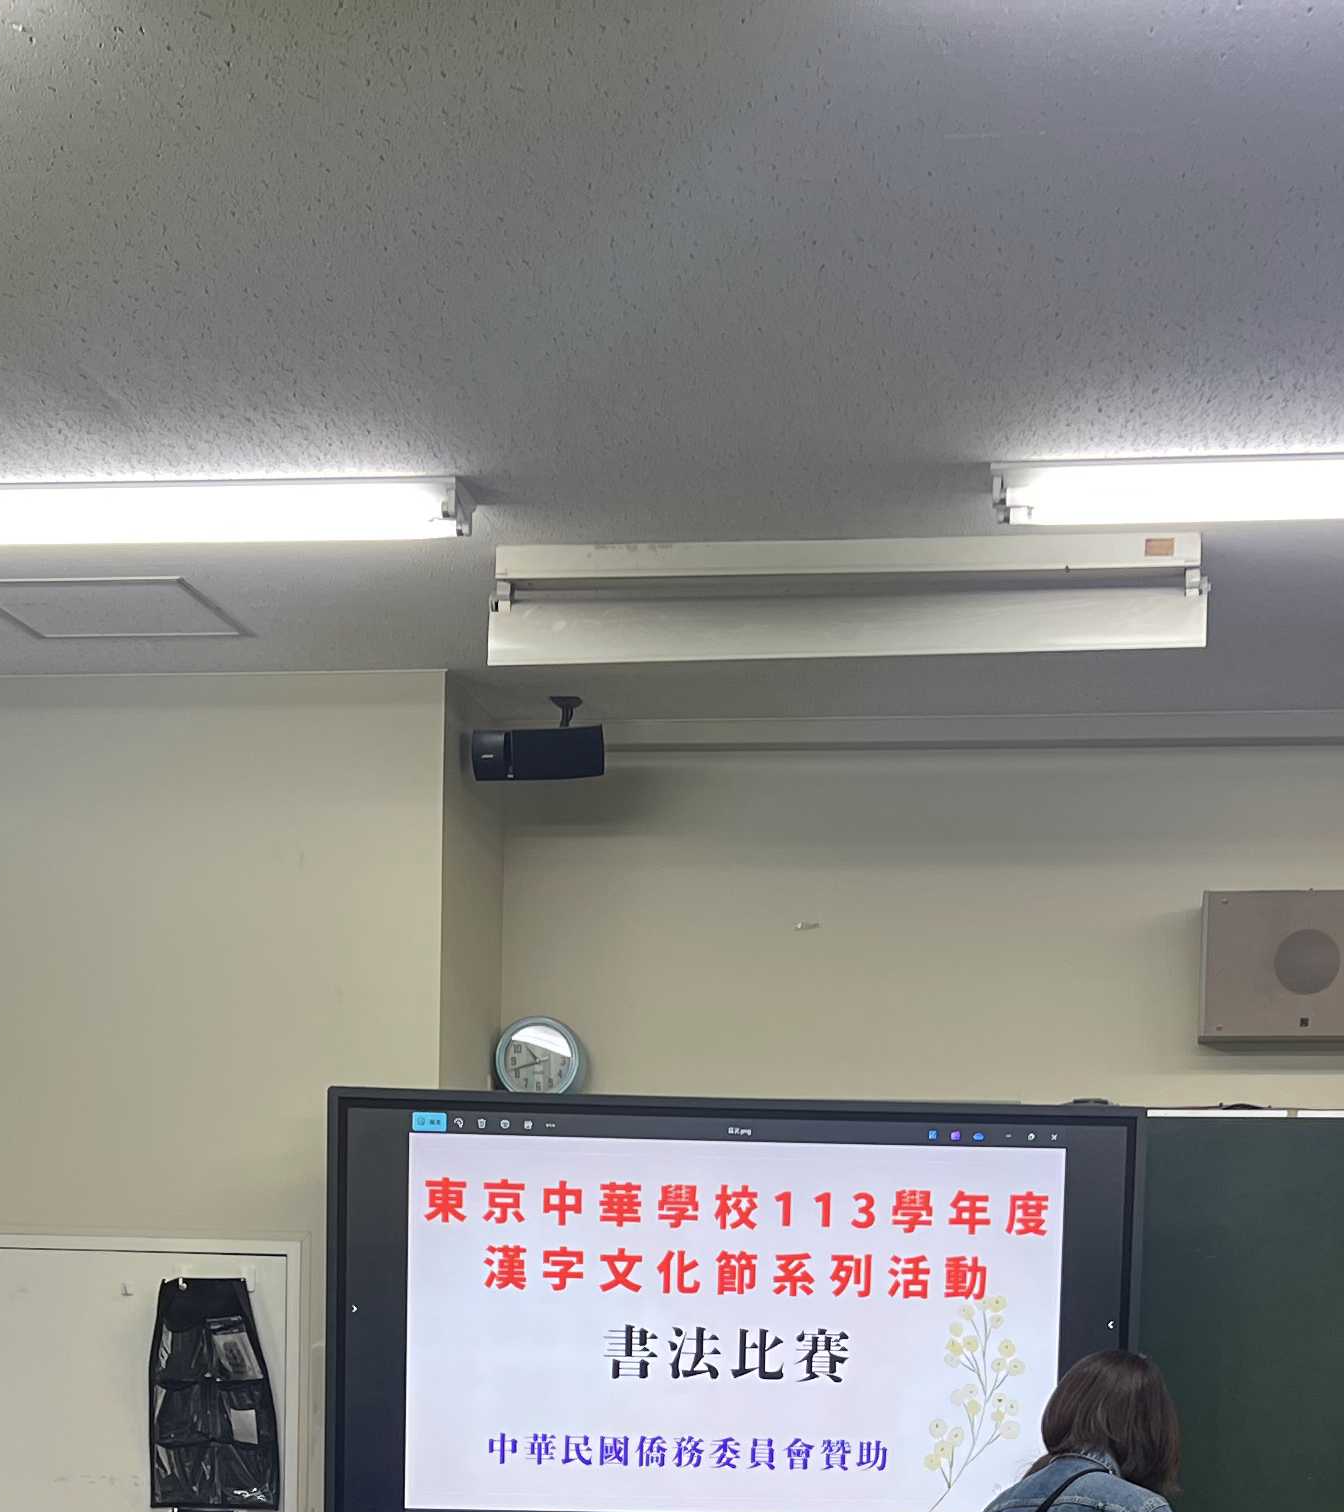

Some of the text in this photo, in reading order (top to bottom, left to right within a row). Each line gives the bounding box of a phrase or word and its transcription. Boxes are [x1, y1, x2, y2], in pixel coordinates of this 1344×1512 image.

[424, 1176, 1051, 1237] 東京中華學校113學年度
[484, 1245, 989, 1301] 漢字文化節系列活動
[603, 1324, 851, 1384] 書法比賽
[487, 1431, 889, 1473] 中華民國僑務委員會贊助
